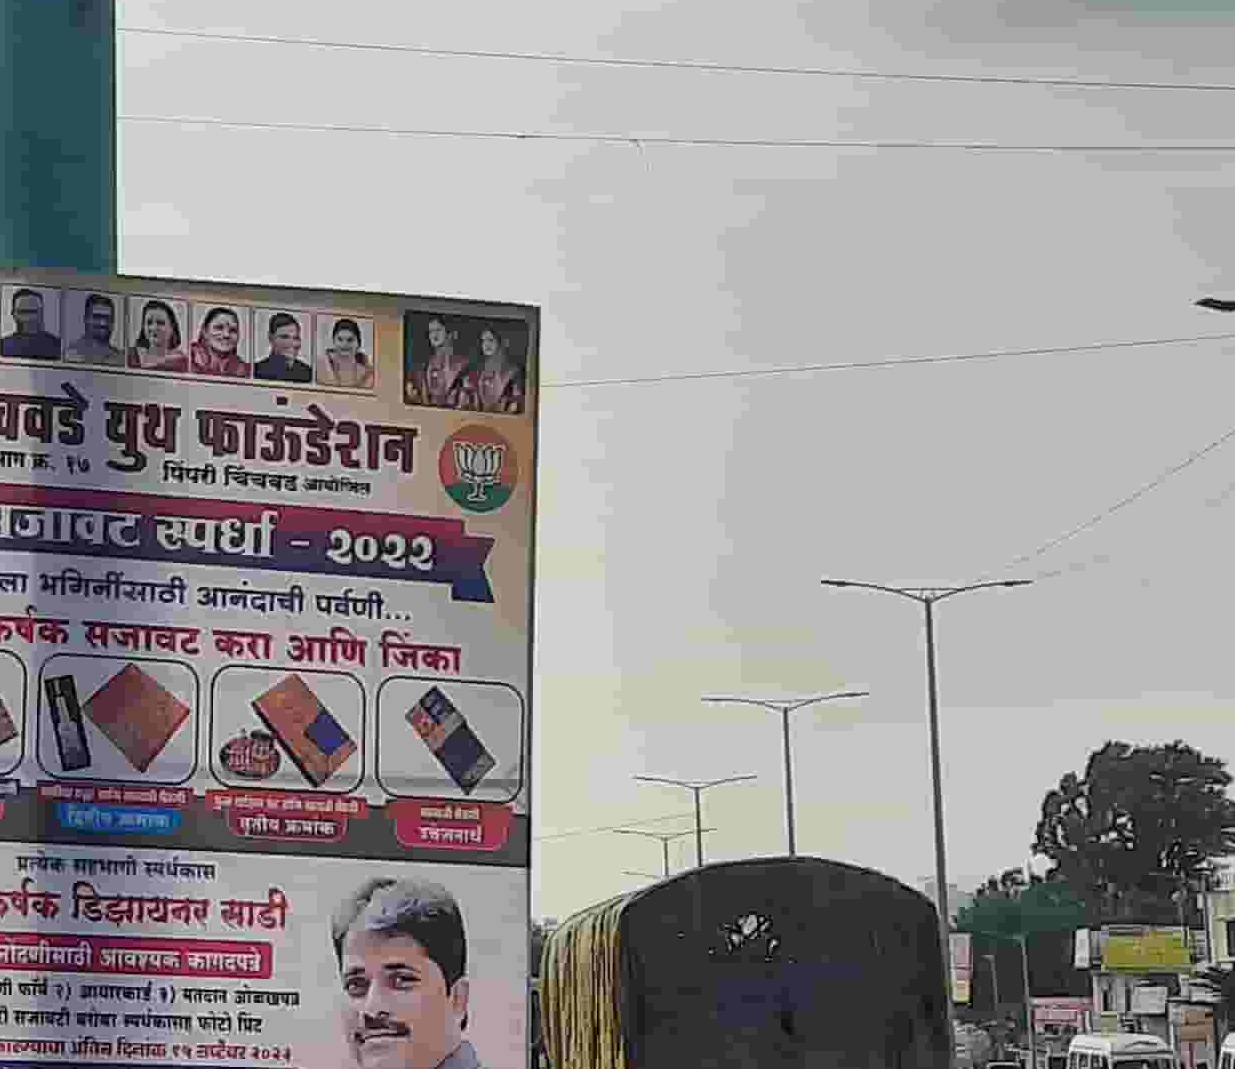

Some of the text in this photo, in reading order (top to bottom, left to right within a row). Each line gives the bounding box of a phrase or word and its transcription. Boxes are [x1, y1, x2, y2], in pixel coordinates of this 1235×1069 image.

[104, 401, 181, 472] युथ
[196, 396, 418, 473] फाऊंडेशन
[156, 509, 278, 558] स्पर्धा
[39, 568, 187, 606] भगिनींसाठी
[196, 580, 303, 615] आनंदाची
[81, 619, 201, 656] सजावट
[212, 629, 272, 660] करा
[286, 626, 367, 668] आणि
[379, 631, 463, 675] जिंका
[72, 881, 210, 926] डिझायनर
[220, 888, 289, 929] साडी
